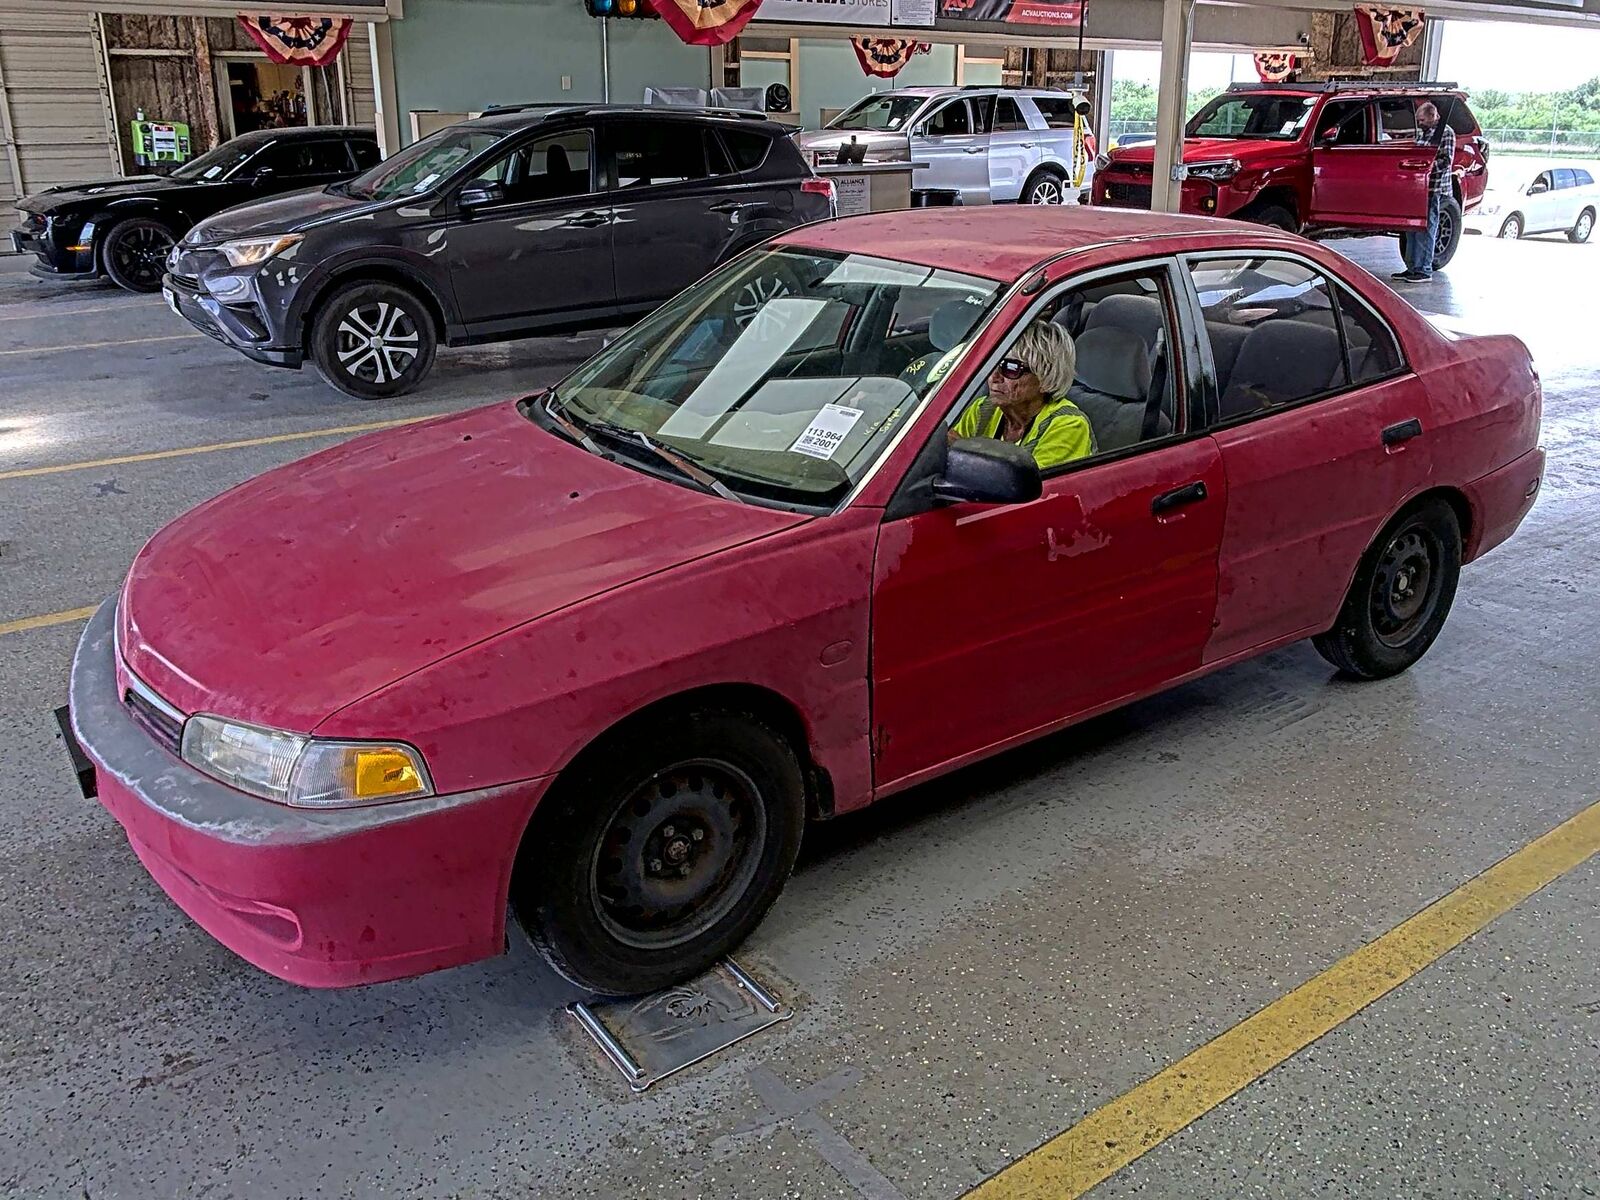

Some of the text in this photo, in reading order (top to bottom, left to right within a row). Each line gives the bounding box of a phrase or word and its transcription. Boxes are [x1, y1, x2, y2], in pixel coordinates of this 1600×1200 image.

[1021, 9, 1073, 19] ACVAUCTIONS.COM
[807, 427, 843, 442] 113,964
[812, 437, 837, 449] 2001
